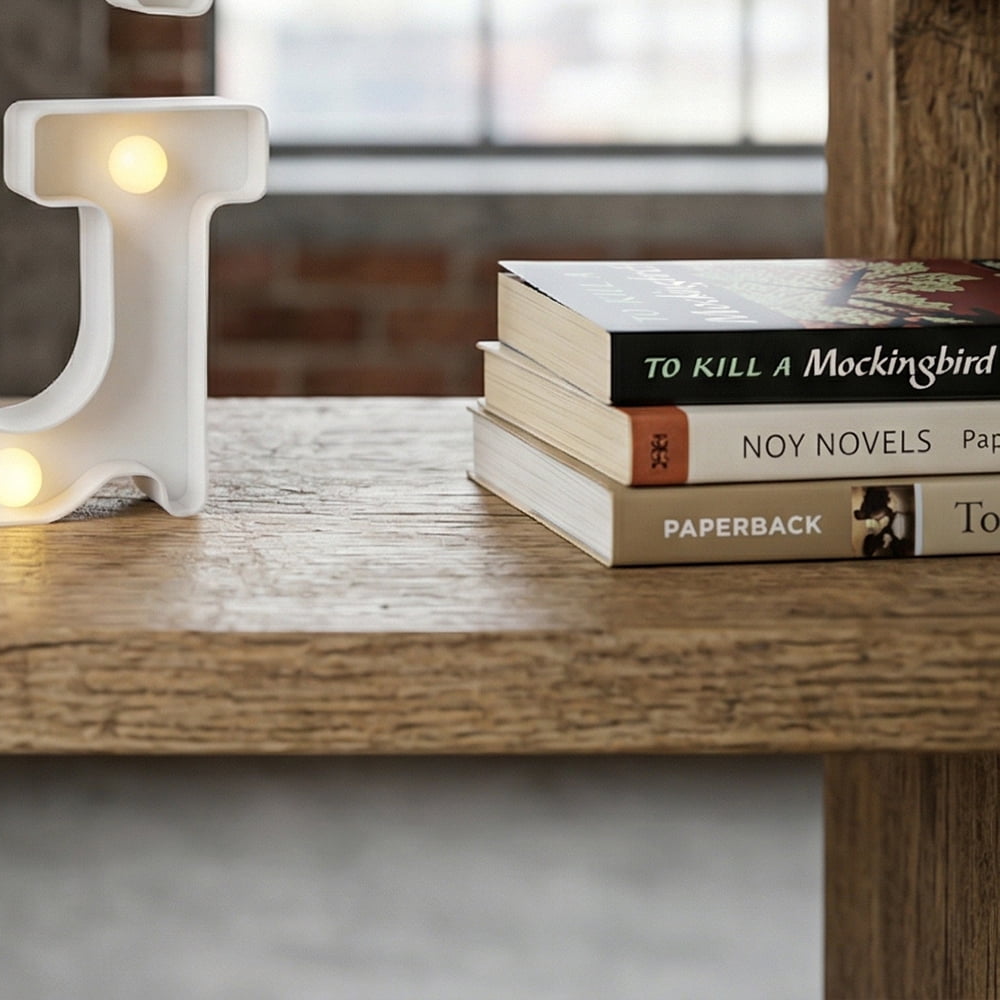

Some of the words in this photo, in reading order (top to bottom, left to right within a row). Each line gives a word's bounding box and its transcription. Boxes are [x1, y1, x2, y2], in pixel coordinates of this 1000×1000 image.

[644, 357, 681, 379] TO
[692, 356, 762, 378] KILL
[772, 356, 792, 377] A
[803, 345, 997, 390] Mockingbird
[743, 433, 805, 458] NOY
[817, 429, 932, 456] NOVELS
[663, 514, 822, 539] PAPERBACK
[954, 501, 1000, 534] To
